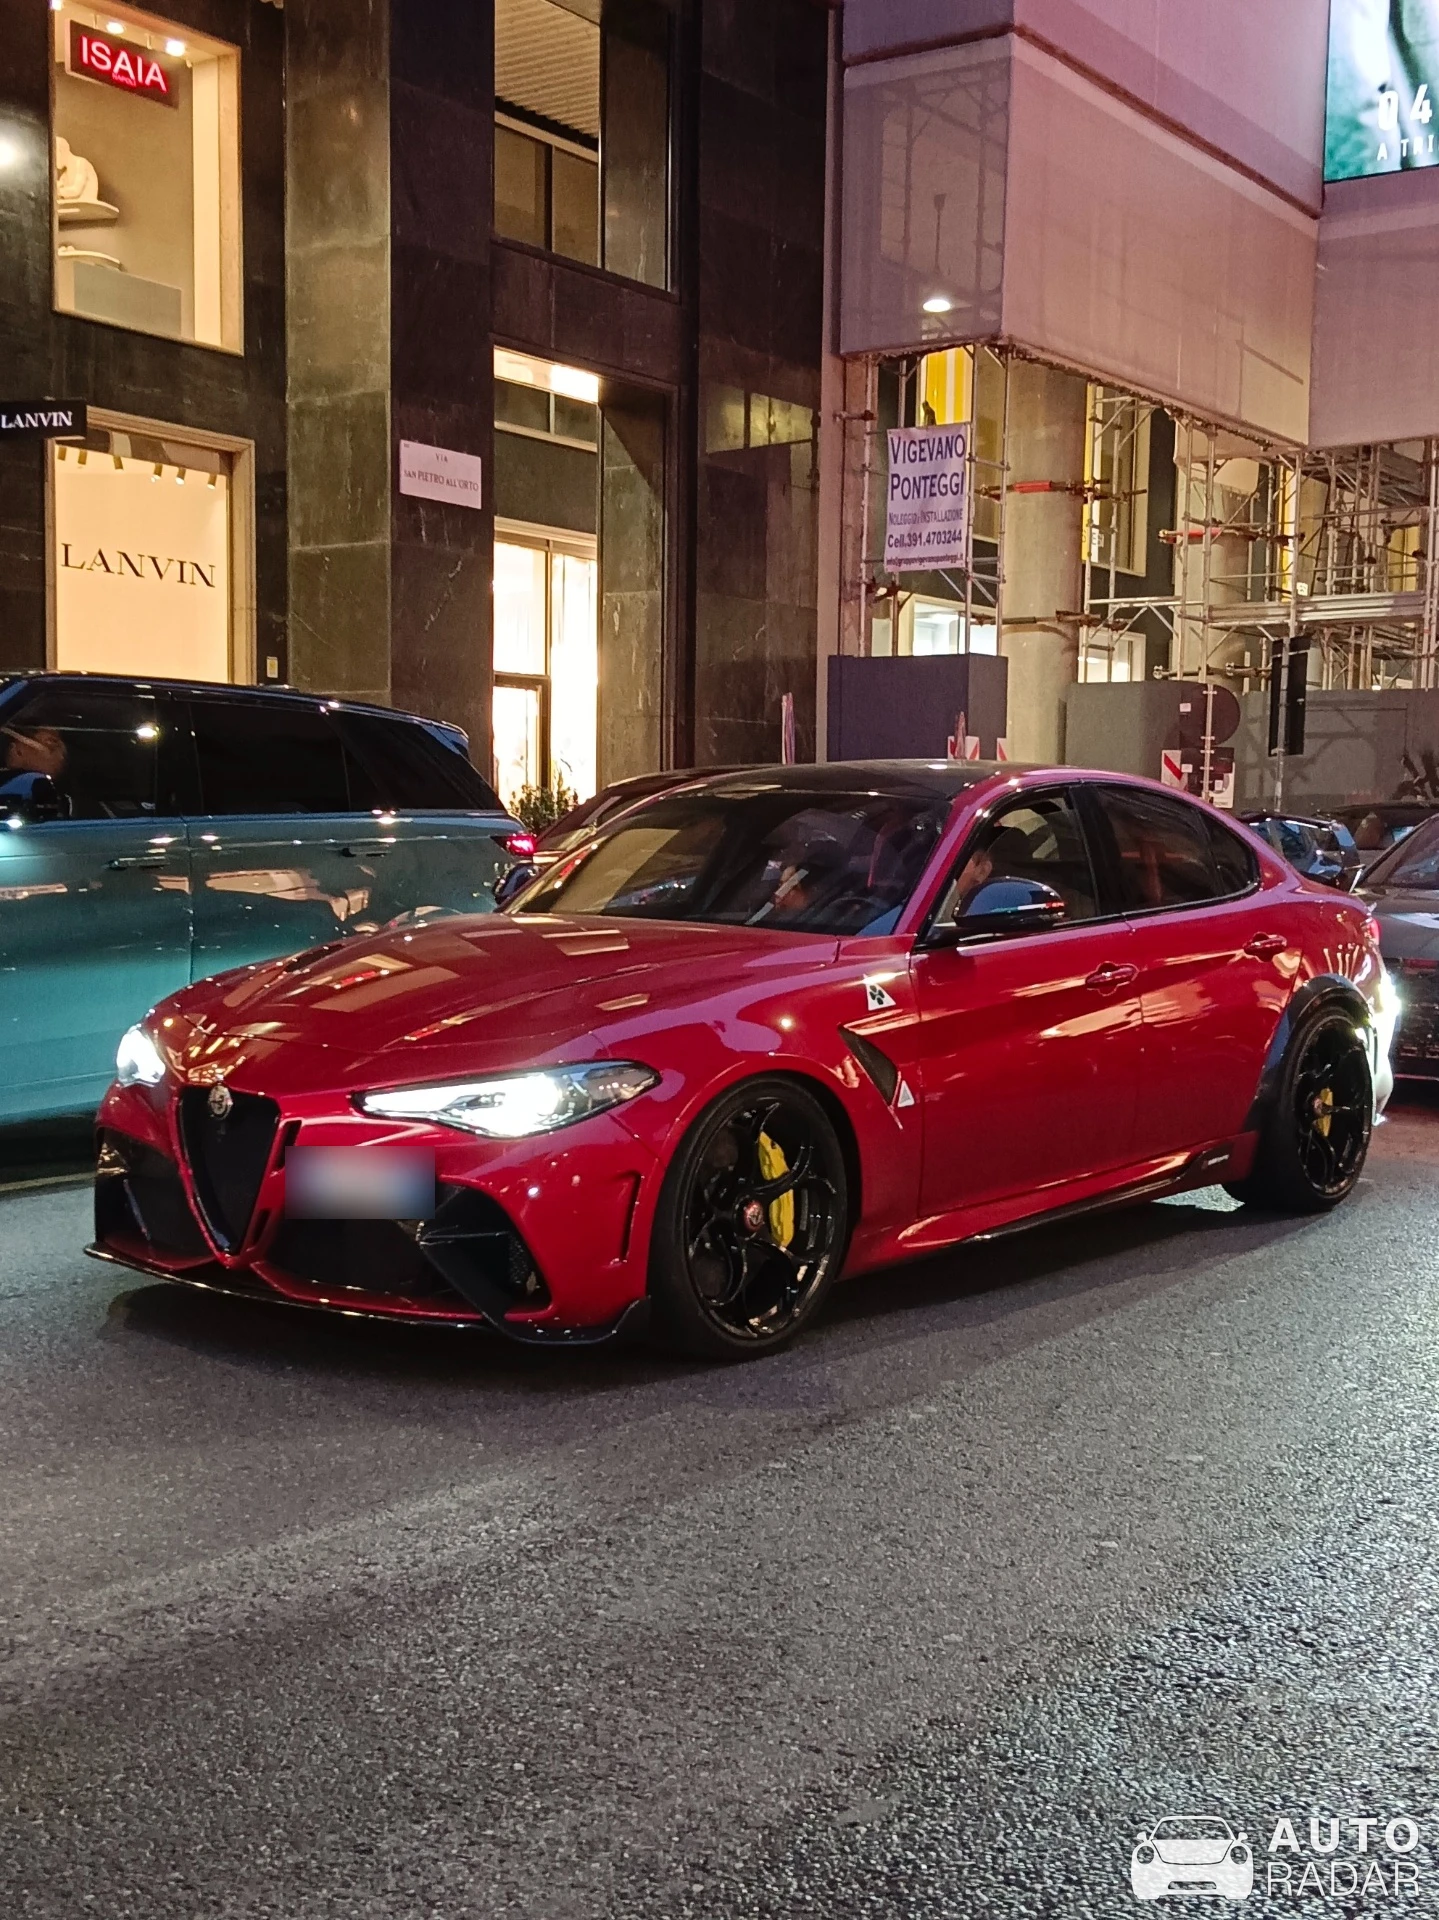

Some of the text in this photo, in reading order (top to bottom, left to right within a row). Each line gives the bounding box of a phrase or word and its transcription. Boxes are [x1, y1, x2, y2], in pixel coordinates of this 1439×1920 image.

[81, 35, 168, 93] ISAIA
[1, 411, 73, 429] LANVIN
[436, 453, 448, 462] VIA
[891, 434, 966, 464] VIGEVANO
[404, 470, 416, 479] SAN
[418, 470, 444, 484] PIETRO
[891, 472, 965, 500] PONTEGGI
[61, 543, 216, 588] LANVIN
